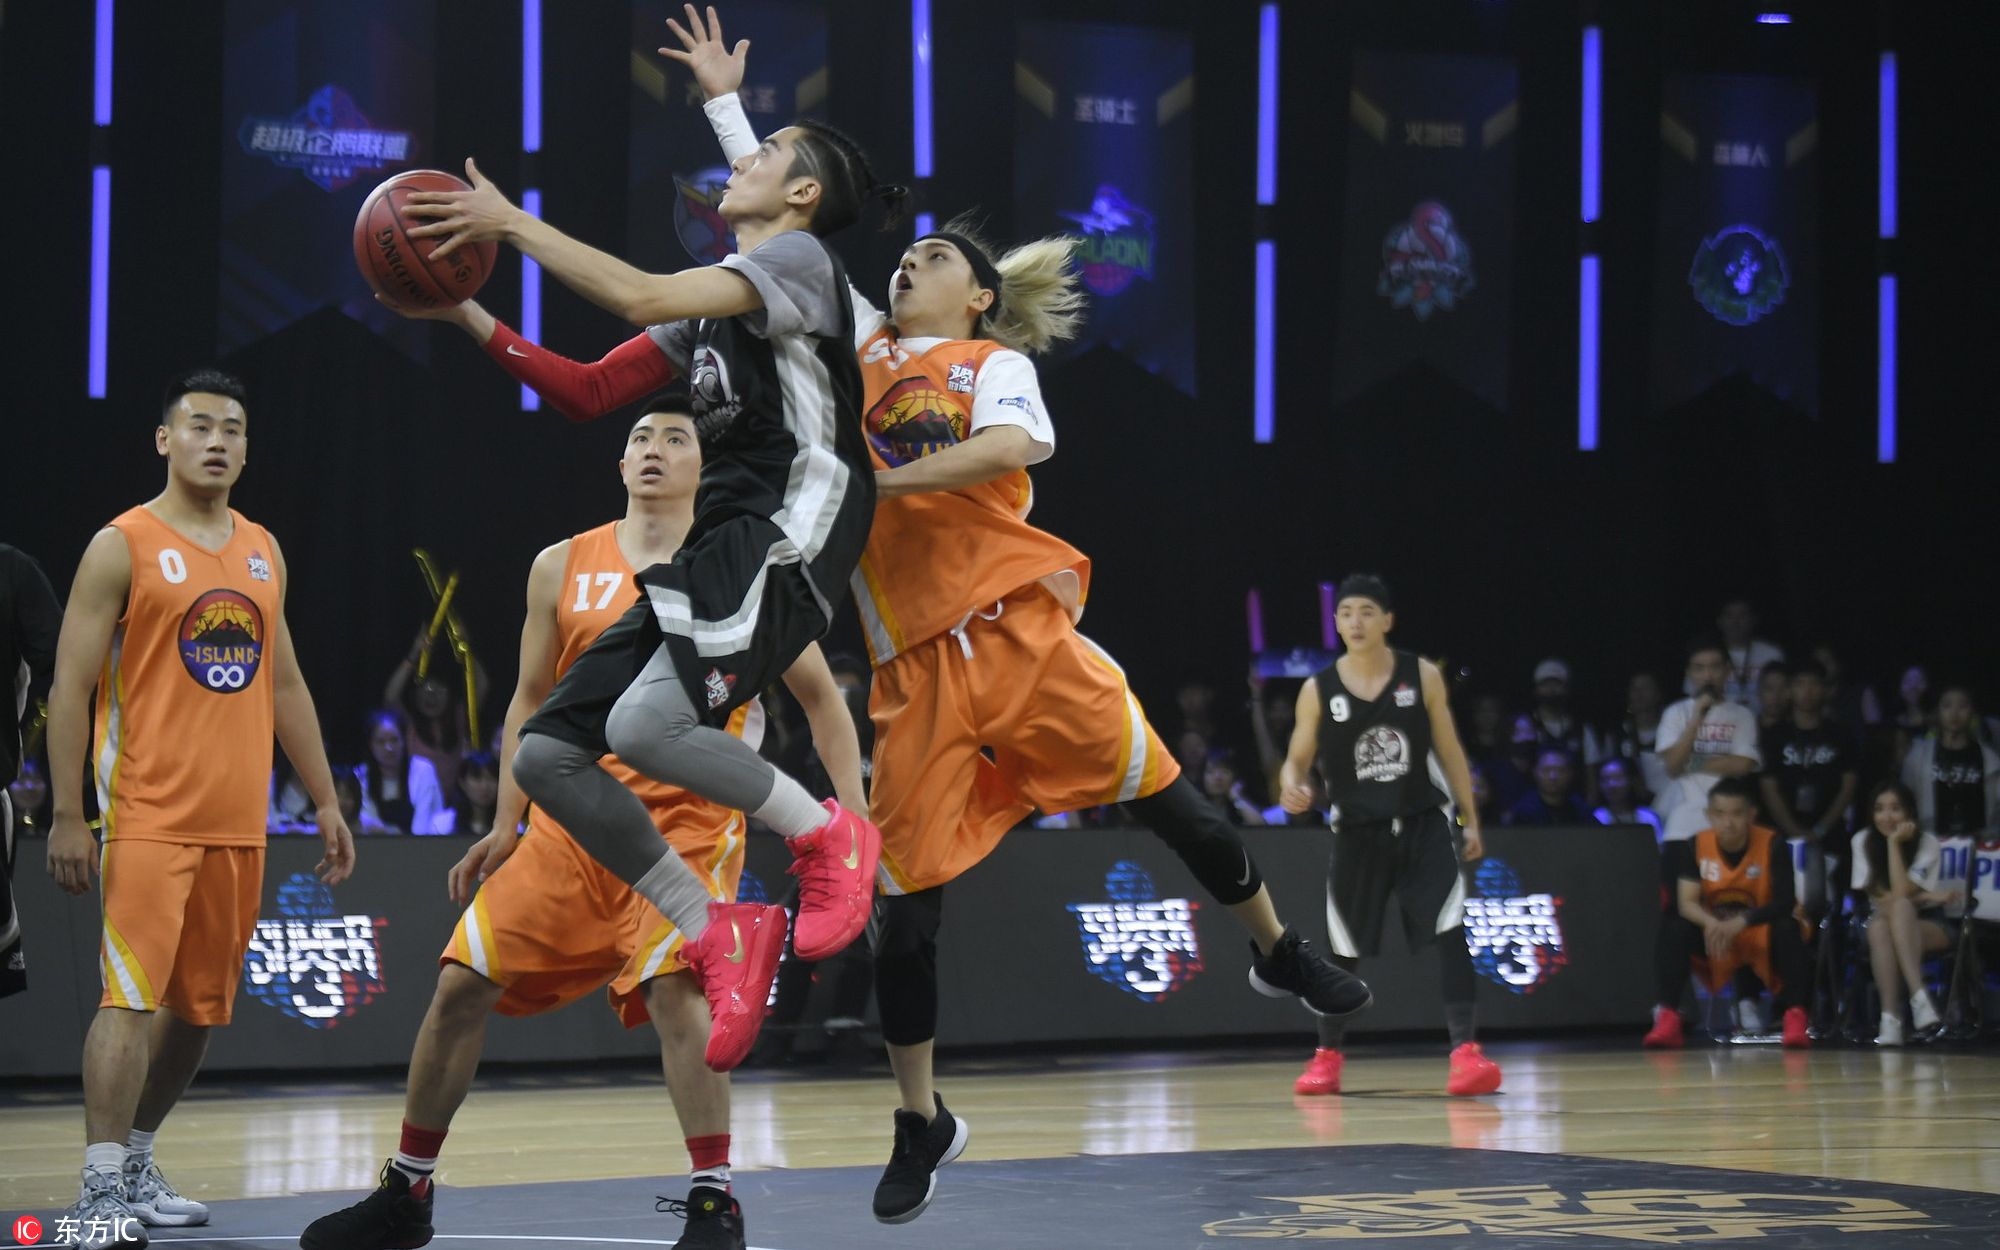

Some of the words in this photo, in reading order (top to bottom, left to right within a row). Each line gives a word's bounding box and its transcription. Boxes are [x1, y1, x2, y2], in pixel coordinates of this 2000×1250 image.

[157, 548, 188, 585] 0
[572, 572, 624, 613] 17
[195, 646, 255, 665] ISLAND
[1330, 694, 1351, 723] 9
